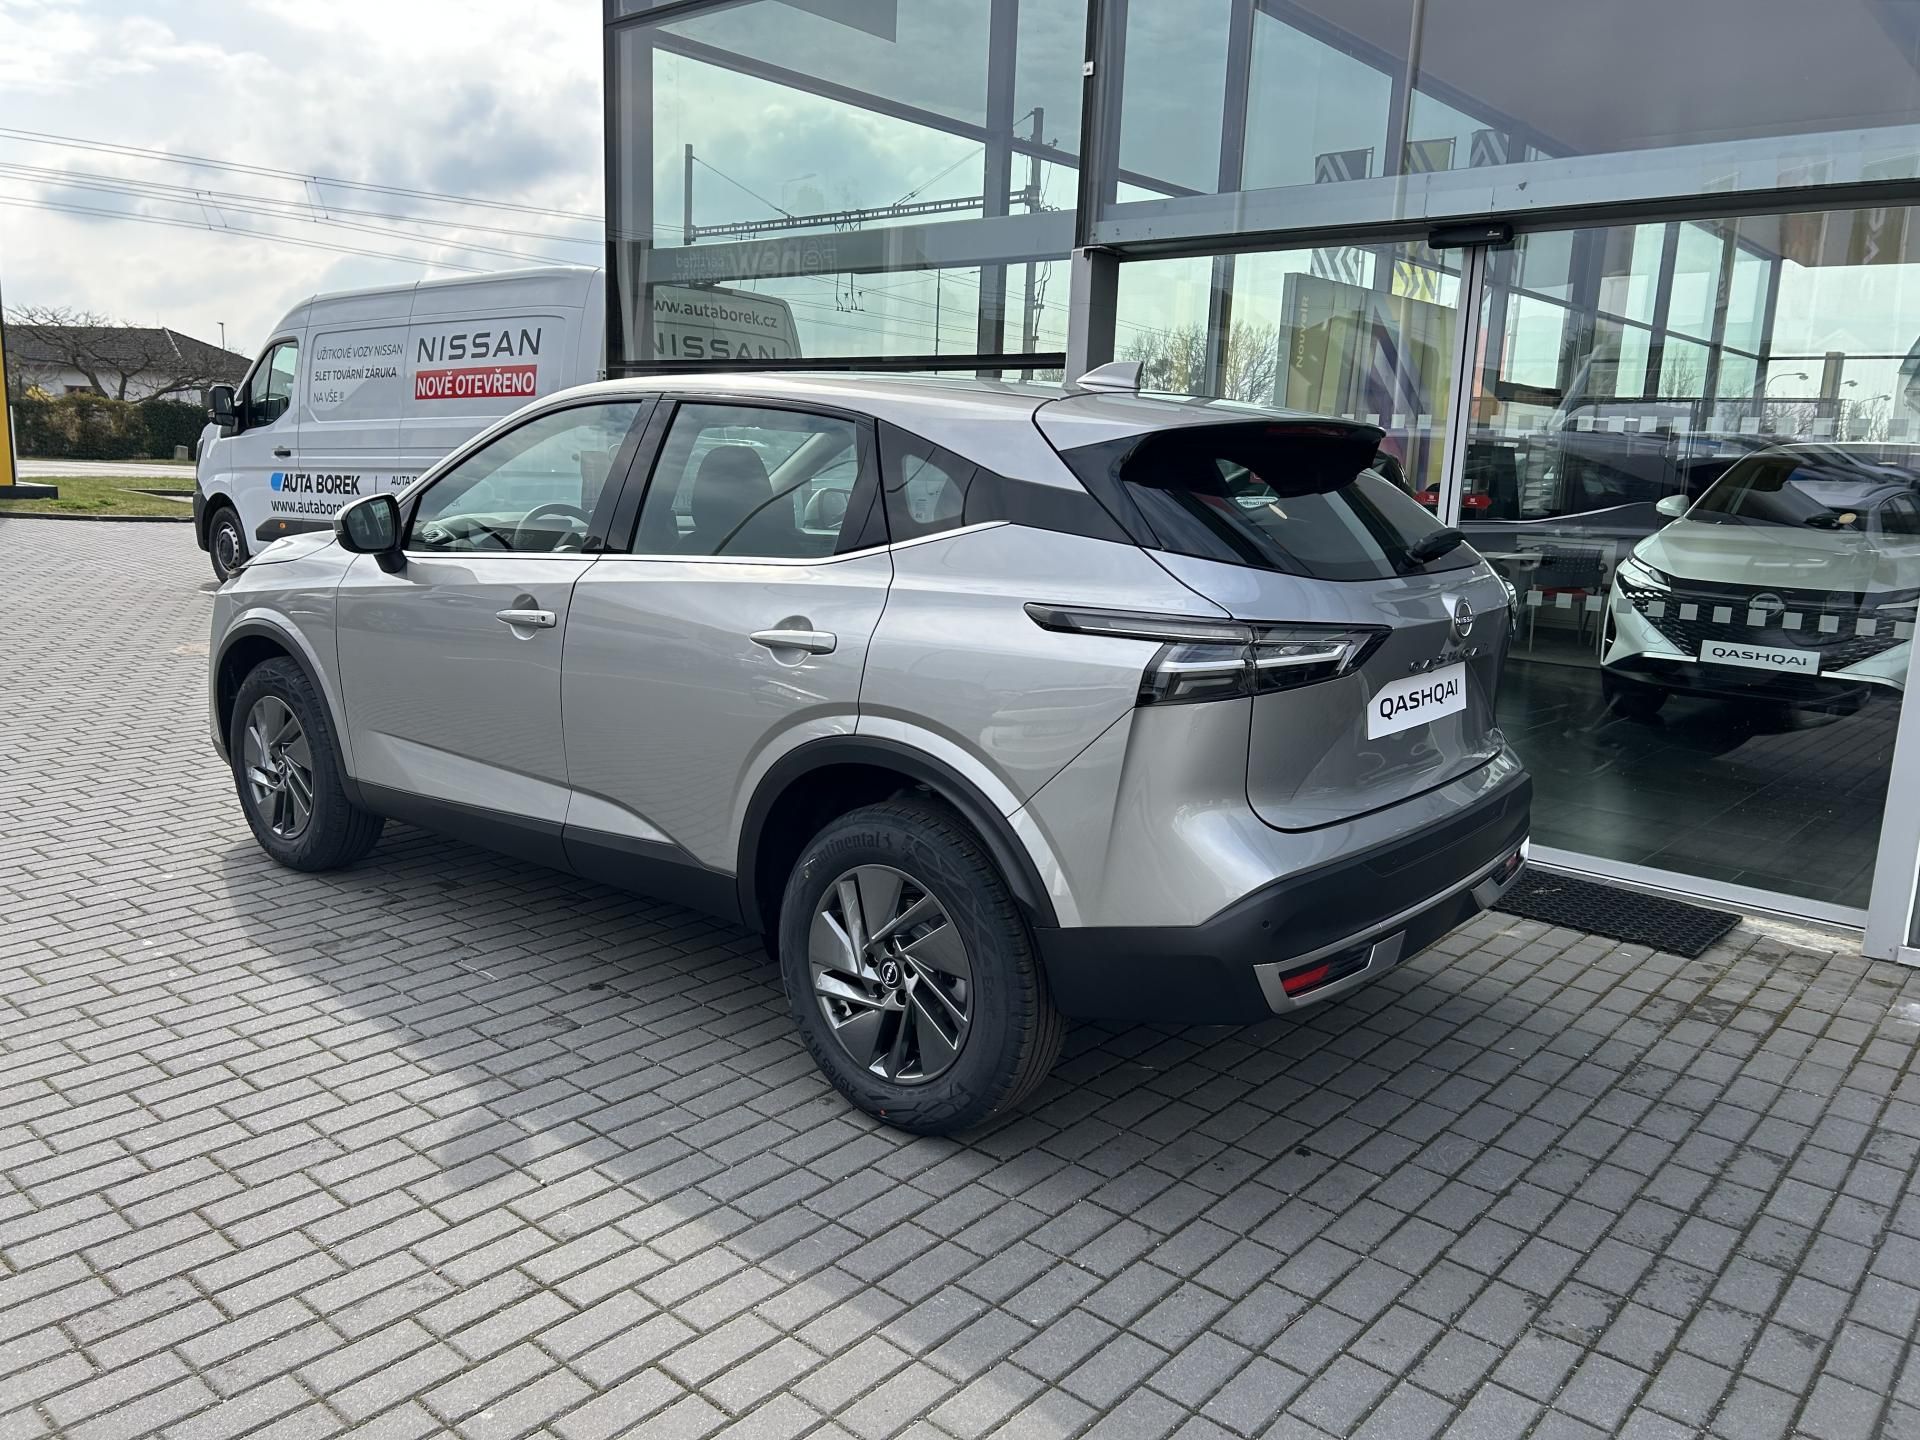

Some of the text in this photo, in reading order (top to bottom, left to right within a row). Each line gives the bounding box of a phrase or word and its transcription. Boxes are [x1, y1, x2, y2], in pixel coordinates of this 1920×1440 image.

[316, 343, 404, 361] UŽITKOVÉ VOZY NISSAN
[417, 328, 542, 363] NISSAN
[332, 365, 365, 381] TOVÁRNÍ
[364, 364, 397, 379] ZÁRUKA
[416, 368, 536, 397] NOVĚ OTEVŘENO
[313, 391, 324, 403] NA
[324, 388, 338, 403] VŠE
[282, 473, 361, 496] AUTA BOREK
[391, 475, 411, 486] AUTA
[1712, 646, 1807, 667] QASHQAI
[1379, 678, 1458, 720] QASHQAI
